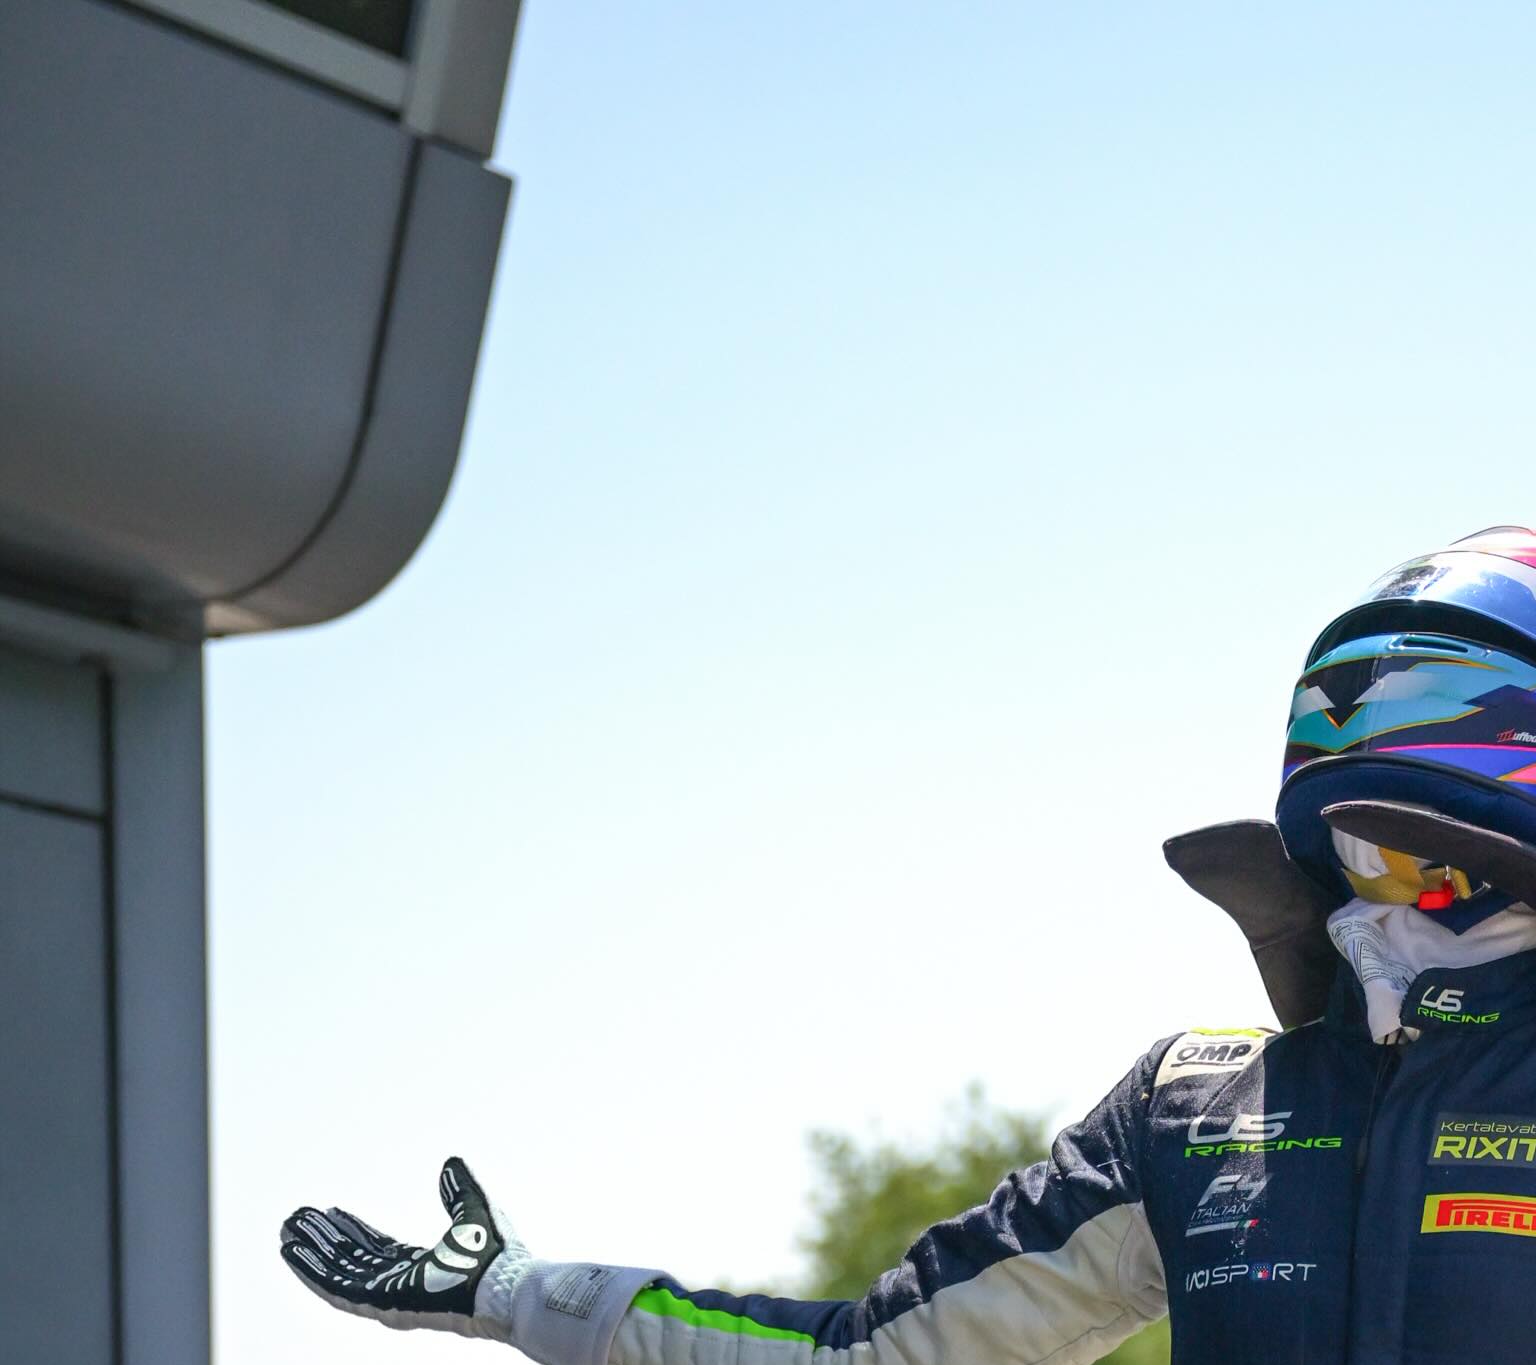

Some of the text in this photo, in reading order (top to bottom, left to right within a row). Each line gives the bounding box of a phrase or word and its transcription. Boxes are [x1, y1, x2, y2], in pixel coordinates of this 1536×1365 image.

[1417, 1006, 1501, 1024] RACING
[1176, 1043, 1252, 1063] OMP
[1183, 1136, 1343, 1159] RACING
[1190, 1202, 1252, 1222] ITALIAN
